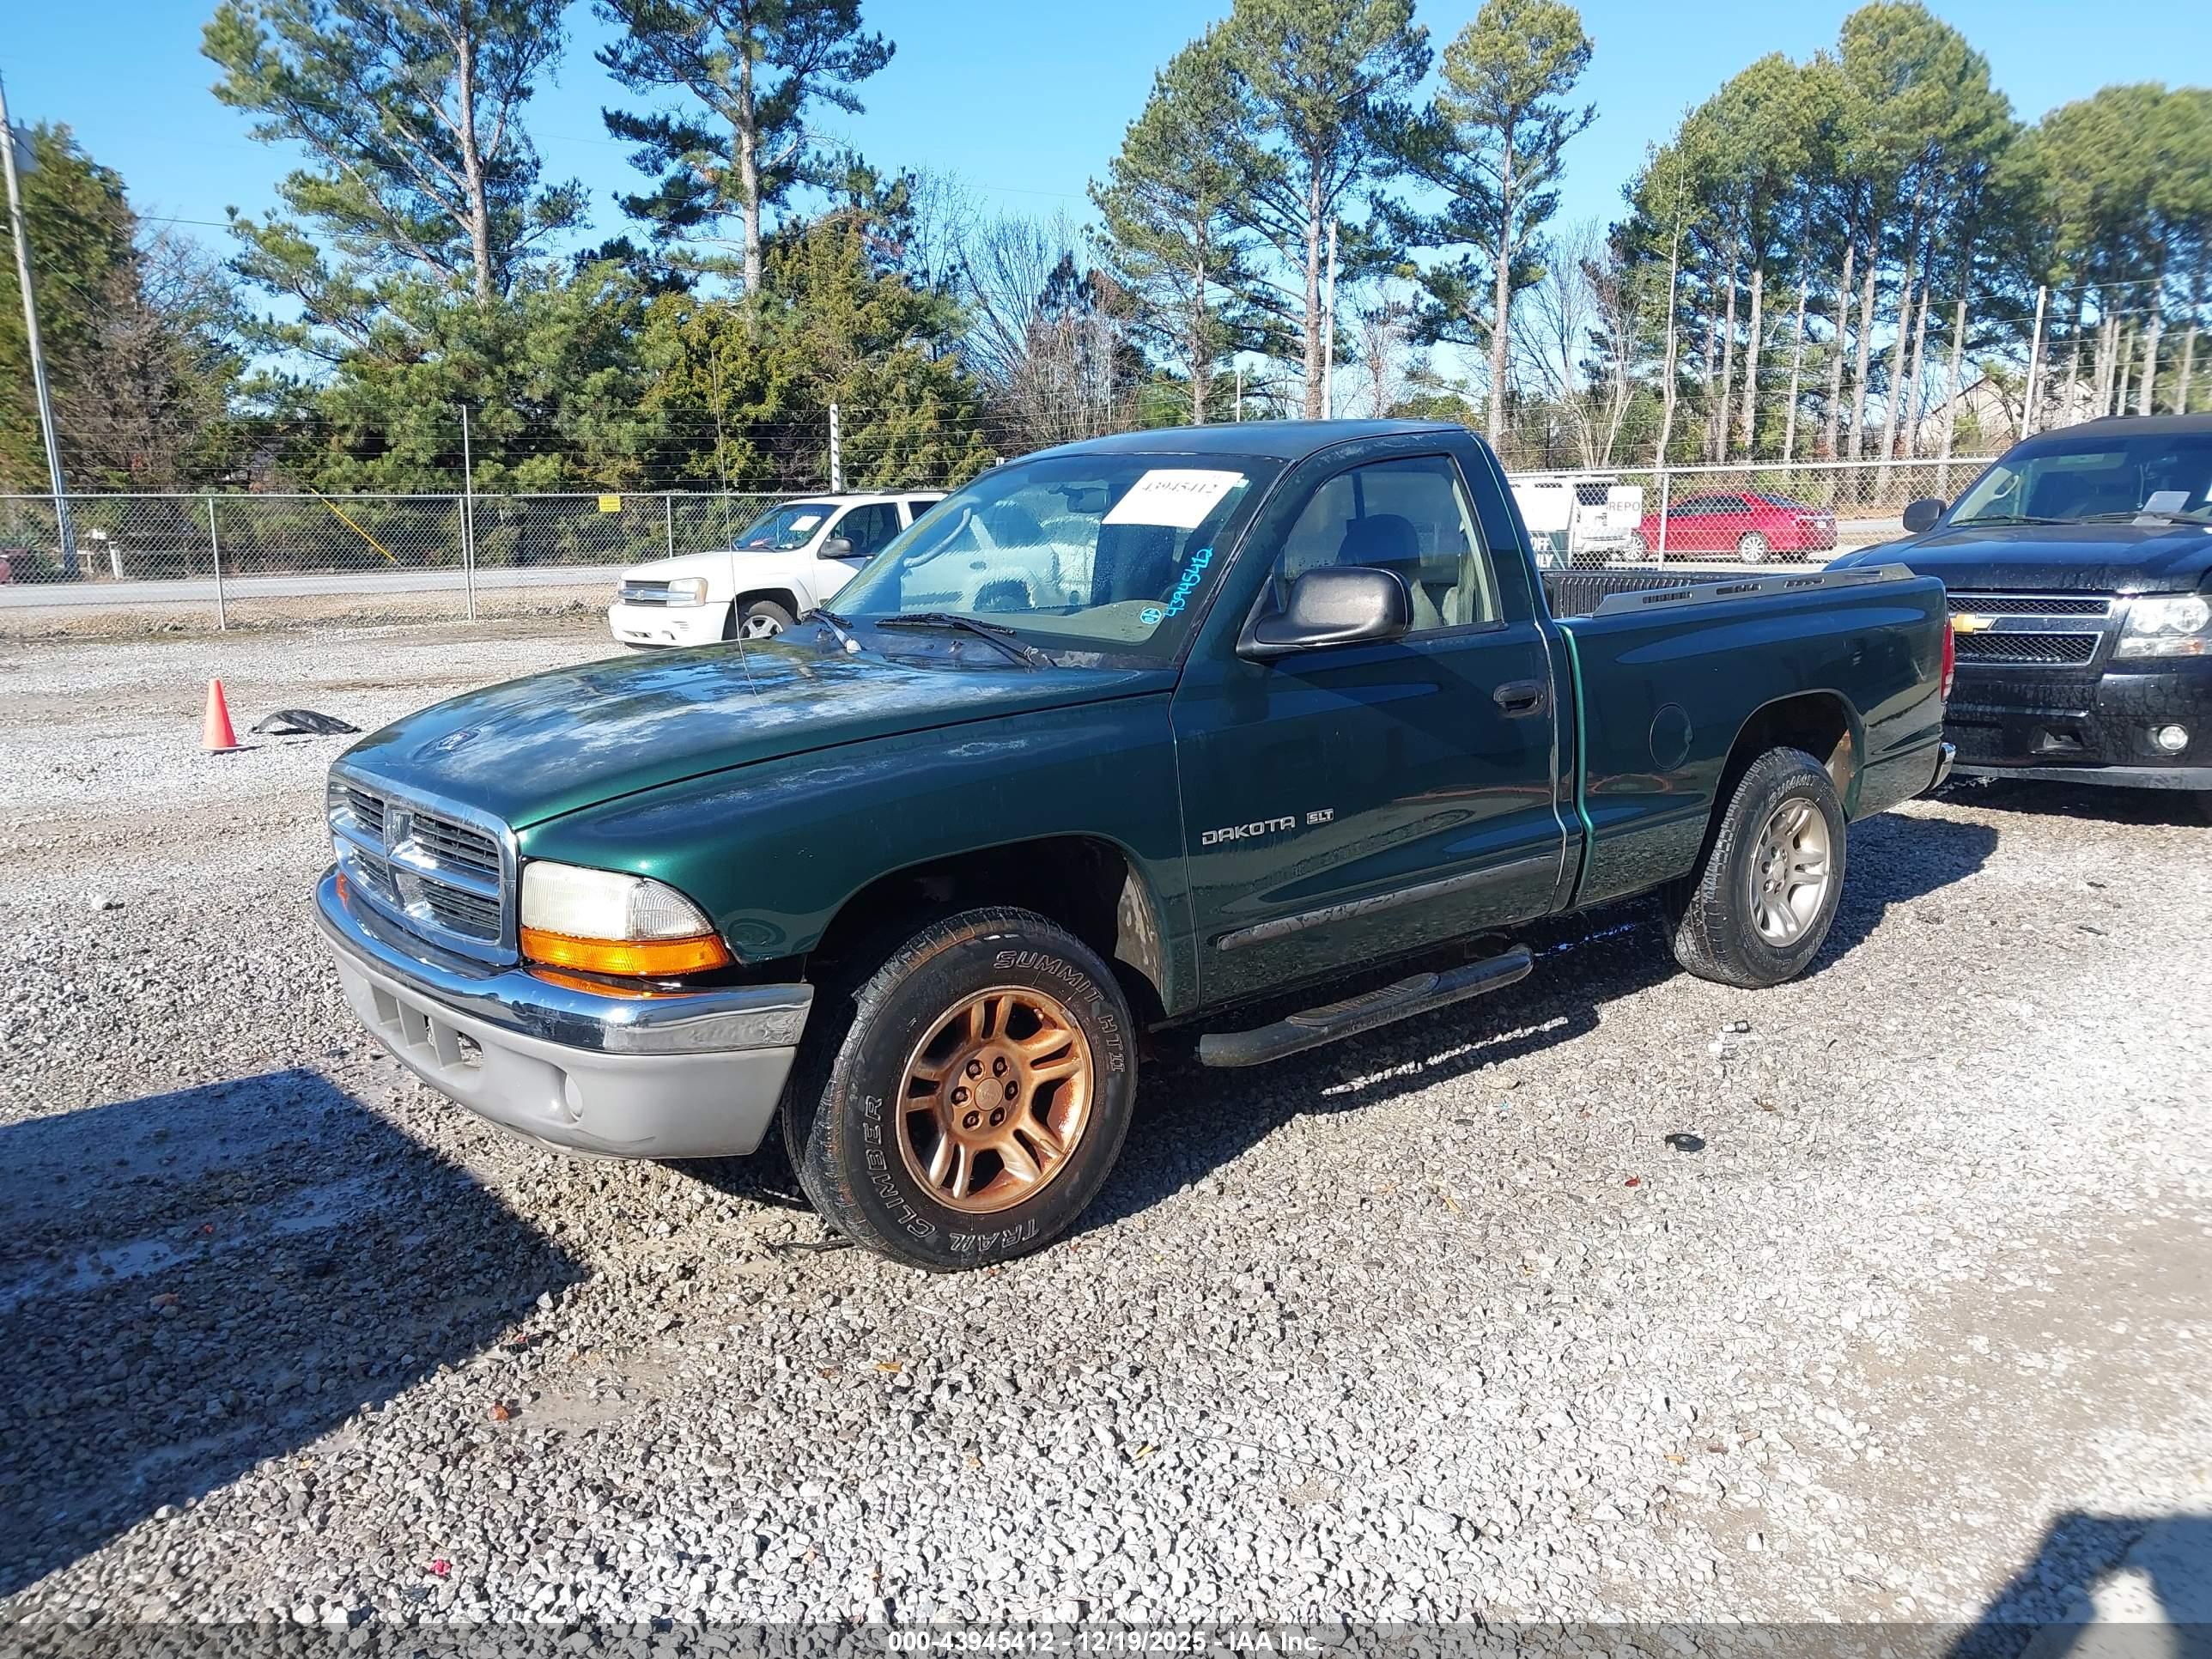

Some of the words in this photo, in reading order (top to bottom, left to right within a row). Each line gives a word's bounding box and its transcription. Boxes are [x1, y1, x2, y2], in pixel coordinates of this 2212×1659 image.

[1608, 501, 1641, 512] REPO
[1164, 547, 1213, 617] 43945412
[1202, 816, 1296, 846] DAKOTA
[1308, 810, 1334, 823] SLT
[994, 951, 1105, 1003] SUMMIT
[1098, 1014, 1123, 1051] HT
[862, 1095, 936, 1238] CLIMBER
[949, 1218, 1040, 1251] TRAIL
